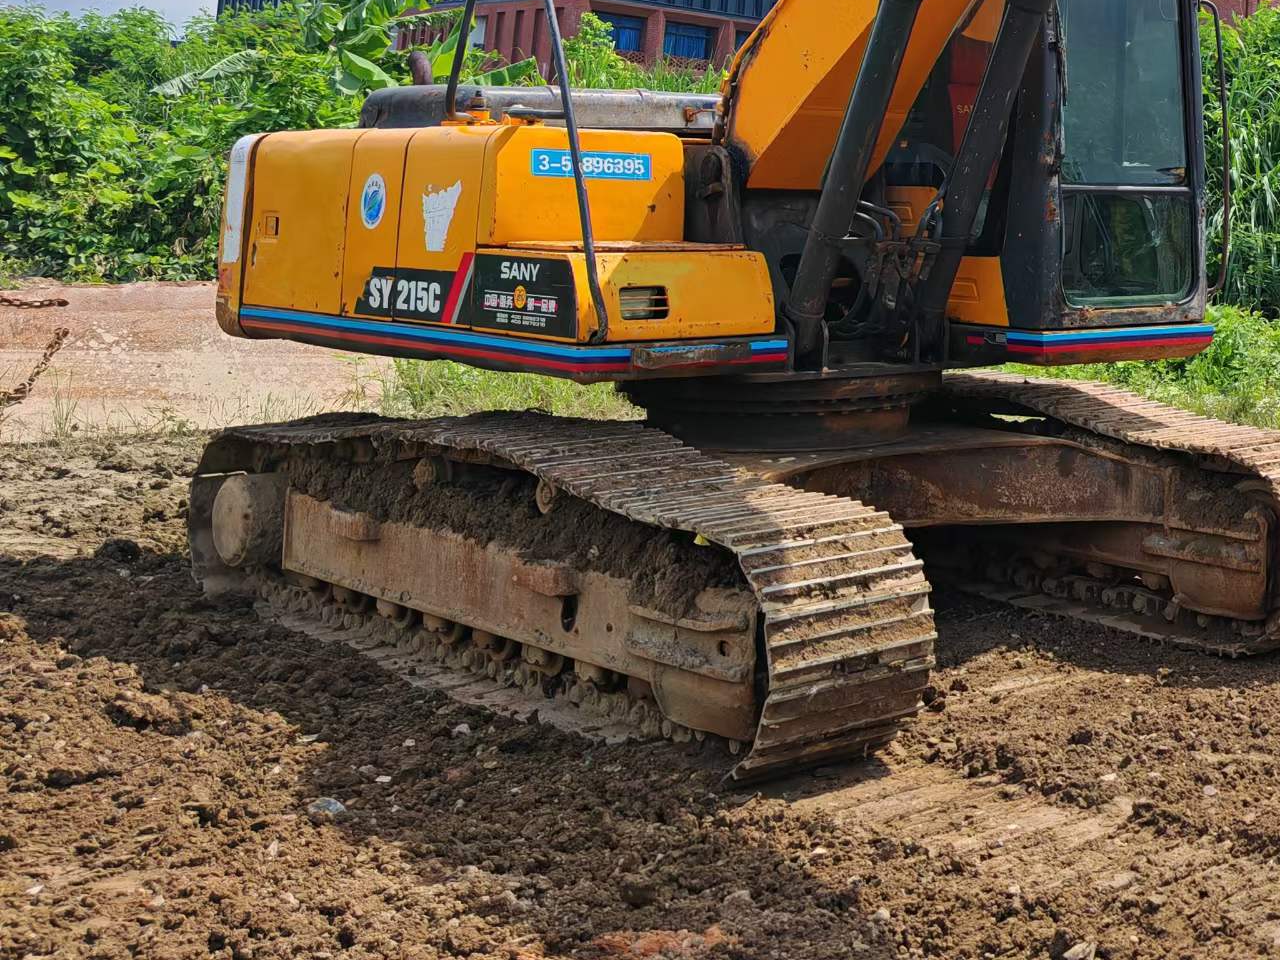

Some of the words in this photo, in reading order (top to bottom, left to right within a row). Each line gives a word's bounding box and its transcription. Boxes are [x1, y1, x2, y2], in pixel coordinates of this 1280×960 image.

[538, 154, 645, 174] 3-5896395
[500, 261, 540, 281] SANY
[369, 277, 393, 308] SY
[396, 279, 441, 313] 215C
